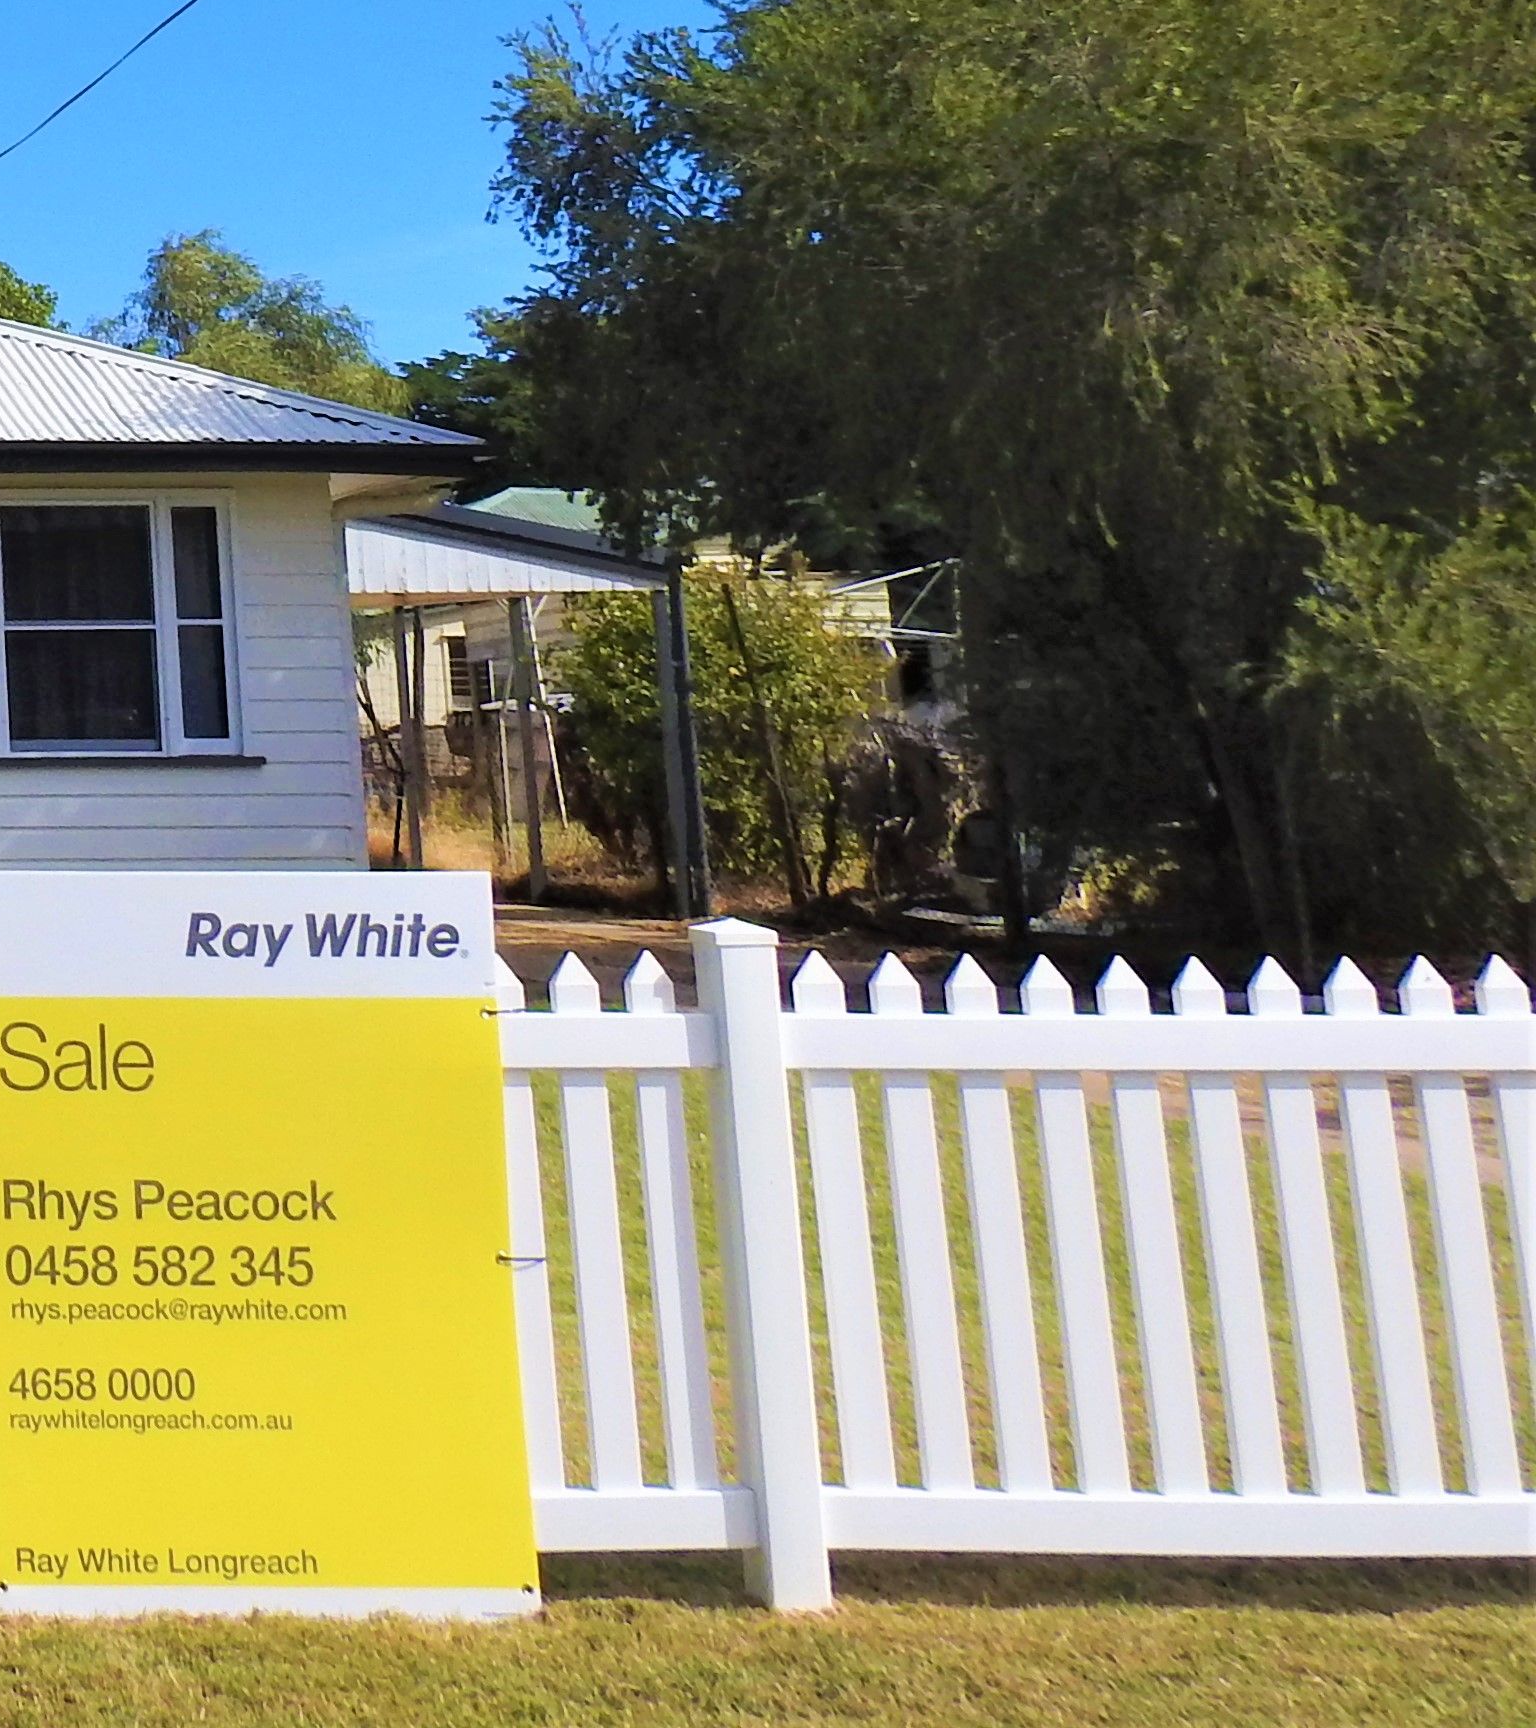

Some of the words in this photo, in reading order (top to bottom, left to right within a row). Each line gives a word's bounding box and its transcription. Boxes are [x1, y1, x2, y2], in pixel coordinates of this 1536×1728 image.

[185, 912, 294, 967] Ray
[305, 913, 460, 959] White
[0, 1021, 155, 1093] Sale
[2, 1178, 119, 1232] Rhys
[133, 1179, 337, 1222] Peacock
[5, 1244, 118, 1287] 0458
[132, 1244, 216, 1287] 582
[230, 1245, 314, 1288] 345
[11, 1297, 347, 1325] rhys.peacock@raywhite.com
[8, 1367, 97, 1402] 4658
[108, 1367, 196, 1402] 0000
[9, 1408, 293, 1434] raywhitelongreach.com.au
[15, 1547, 69, 1580] Ray
[77, 1547, 159, 1574] White
[168, 1547, 319, 1580] Longreach
